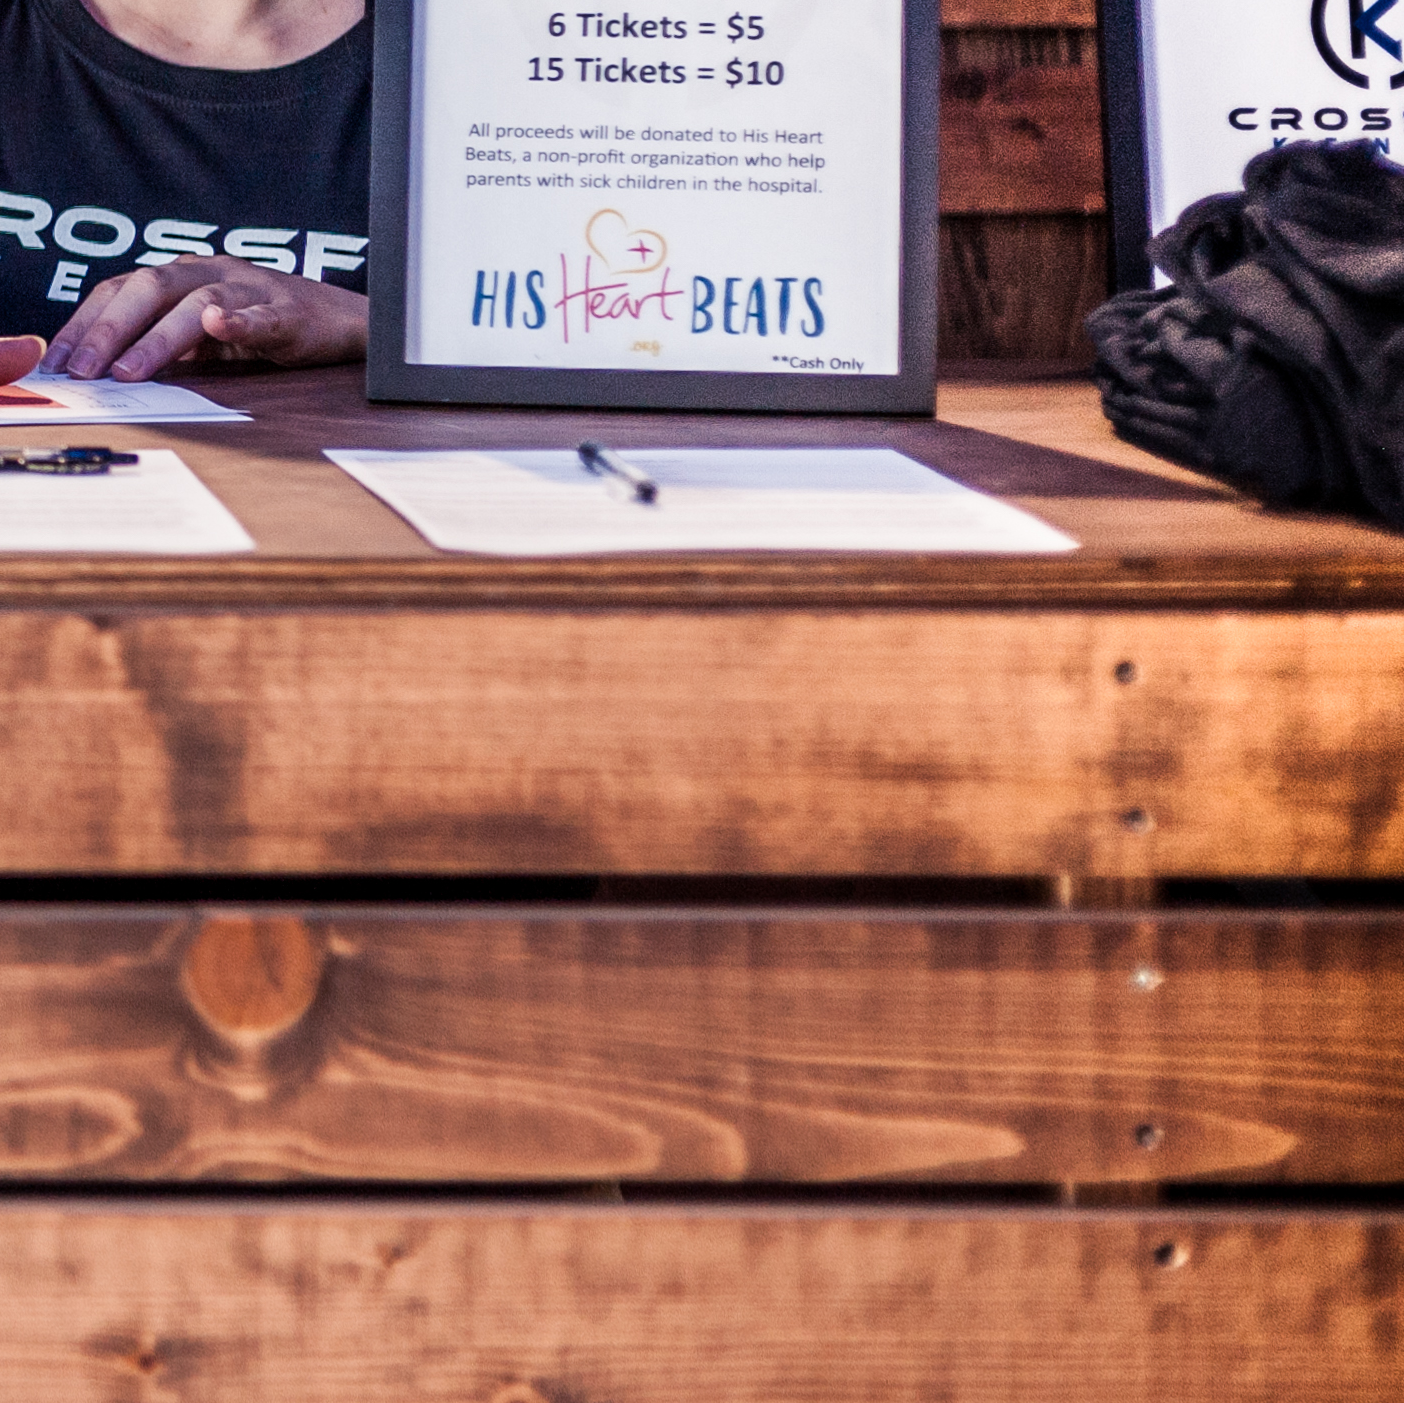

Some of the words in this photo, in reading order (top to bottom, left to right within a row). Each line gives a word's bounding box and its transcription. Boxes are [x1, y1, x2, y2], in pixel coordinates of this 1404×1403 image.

[549, 13, 565, 37] 6
[576, 13, 687, 39] Tickets
[699, 23, 715, 34] =
[727, 12, 764, 43] $5
[529, 57, 564, 81] 15
[575, 57, 686, 84] Tickets
[698, 68, 714, 79] =
[726, 57, 784, 88] $10
[1228, 107, 1404, 131] CROS
[469, 123, 489, 137] All
[496, 125, 573, 140] proceeds
[580, 126, 608, 139] will
[615, 126, 635, 140] be
[641, 127, 713, 142] donated
[719, 130, 737, 142] to
[743, 129, 768, 143] His
[775, 130, 822, 144] Heart
[466, 147, 516, 163] Beats,
[522, 151, 531, 162] a
[538, 149, 625, 166] non-profit
[631, 152, 738, 168] organization
[745, 153, 782, 167] who
[788, 154, 825, 171] help
[467, 174, 531, 188] parents
[537, 174, 573, 187] with
[580, 174, 611, 188] sick
[617, 175, 686, 190] children
[693, 177, 707, 190] in
[714, 177, 742, 191] the
[748, 178, 822, 195] hospital.
[472, 270, 546, 329] HIS
[555, 252, 684, 344] Heart
[692, 276, 824, 337] BEATS
[830, 358, 864, 373] Only
